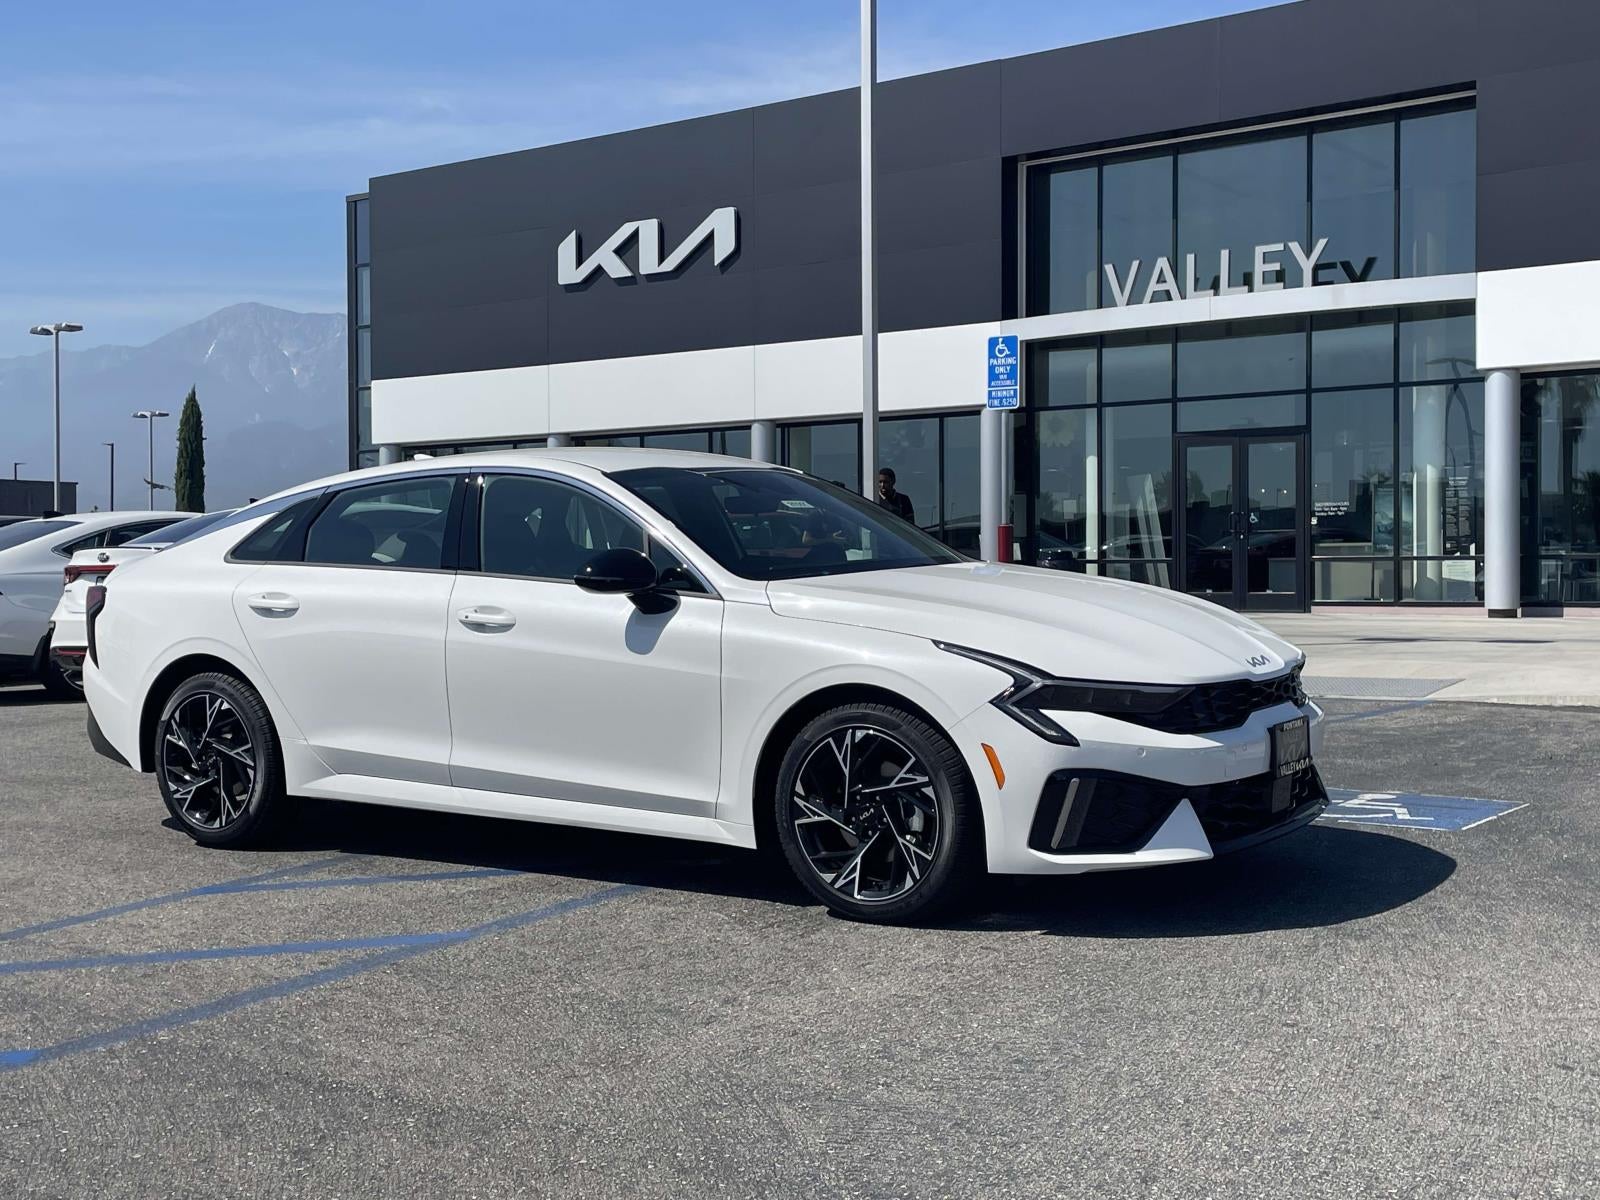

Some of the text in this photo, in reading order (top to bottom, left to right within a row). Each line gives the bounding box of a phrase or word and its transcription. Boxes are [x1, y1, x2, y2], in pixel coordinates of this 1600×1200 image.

[558, 207, 737, 285] KIA
[1104, 238, 1329, 307] VALLEY
[989, 357, 1016, 366] PARKING
[995, 366, 1011, 374] ONLY
[991, 389, 1014, 398] MINIMUM
[1002, 397, 1017, 407] $250
